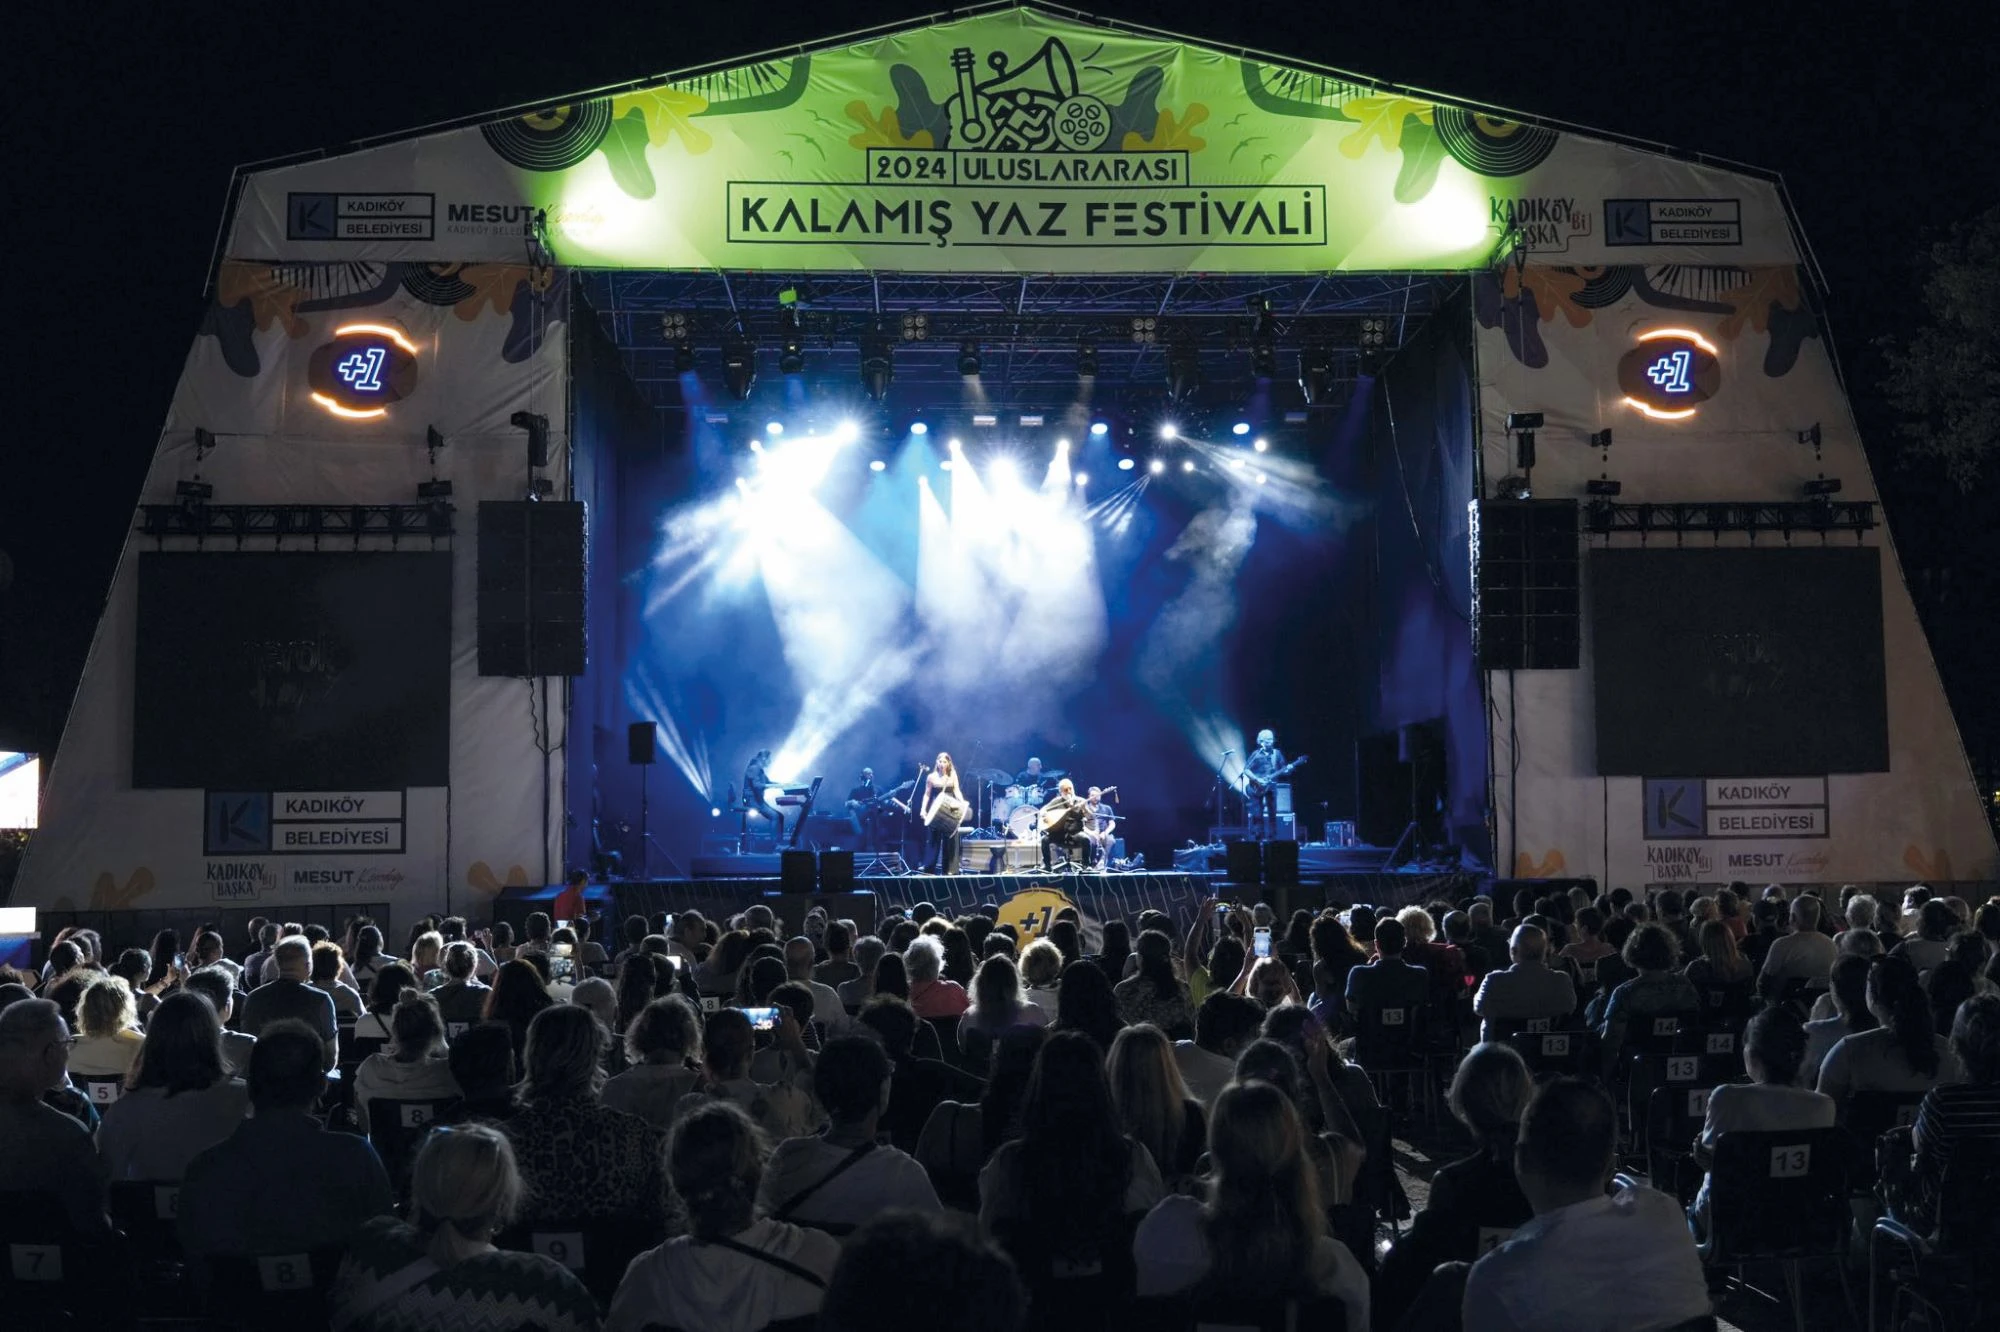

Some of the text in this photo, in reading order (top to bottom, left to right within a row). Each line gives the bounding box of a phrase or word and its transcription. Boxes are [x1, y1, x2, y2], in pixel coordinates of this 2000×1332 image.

[876, 155, 1177, 182] 2024 ULUSLARARASI
[347, 200, 405, 213] KADIKÖY
[448, 204, 535, 223] MESUT
[1490, 196, 1575, 223] KADIKÖY
[1659, 206, 1712, 218] KADIKÖY
[346, 222, 422, 234] BELEDİYESİ
[742, 191, 1313, 248] KALAMIŞ YAZ FESTİVALİ
[1512, 223, 1562, 250] ŞKA
[1660, 226, 1730, 239] BELEDİYESİ
[338, 348, 386, 391] +1
[1647, 351, 1690, 392] +1
[1718, 783, 1791, 800] KADIKÖY
[286, 796, 365, 813] KADIKÖY
[1719, 812, 1814, 830] BELEDİYESİ
[285, 827, 389, 845] BELEDİYESİ
[1647, 845, 1702, 864] KADIKÖY
[1728, 853, 1785, 867] MESUT
[207, 861, 265, 880] KADIKÖY
[294, 870, 354, 884] MESUT
[1657, 864, 1692, 881] BAŞKA
[1020, 906, 1054, 937] +1
[706, 1000, 714, 1010] 8
[1384, 1010, 1402, 1022] 13
[1545, 1039, 1566, 1053] 13
[1711, 1038, 1730, 1050] 14
[1670, 1061, 1693, 1077] 13
[97, 1087, 109, 1100] 5
[411, 1109, 423, 1124] 8
[1775, 1151, 1806, 1173] 13
[548, 1240, 568, 1262] 9
[26, 1252, 45, 1273] 7
[275, 1262, 294, 1283] 8
